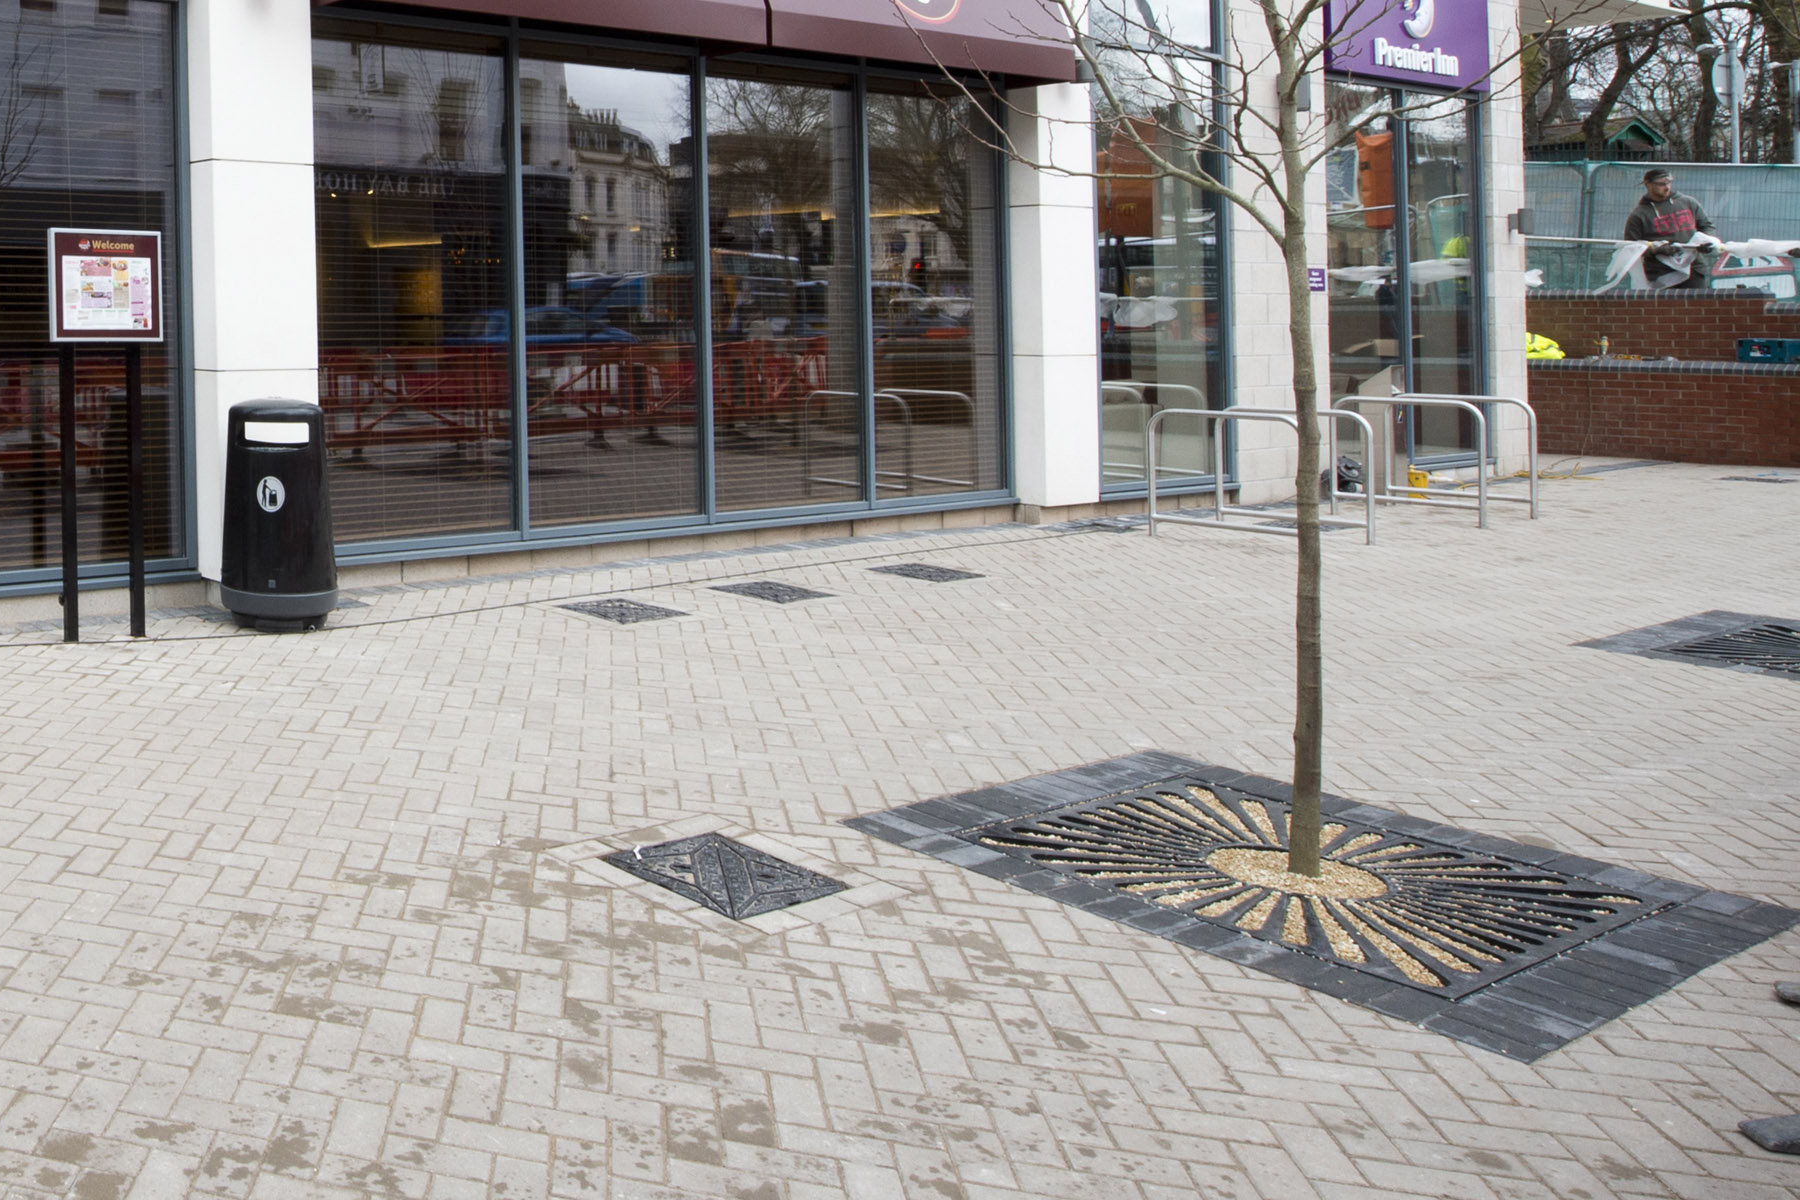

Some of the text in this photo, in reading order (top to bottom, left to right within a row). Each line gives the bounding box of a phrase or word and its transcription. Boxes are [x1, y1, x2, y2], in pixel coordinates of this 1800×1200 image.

[1374, 37, 1459, 77] Premier Inn
[92, 240, 135, 251] Welcome
